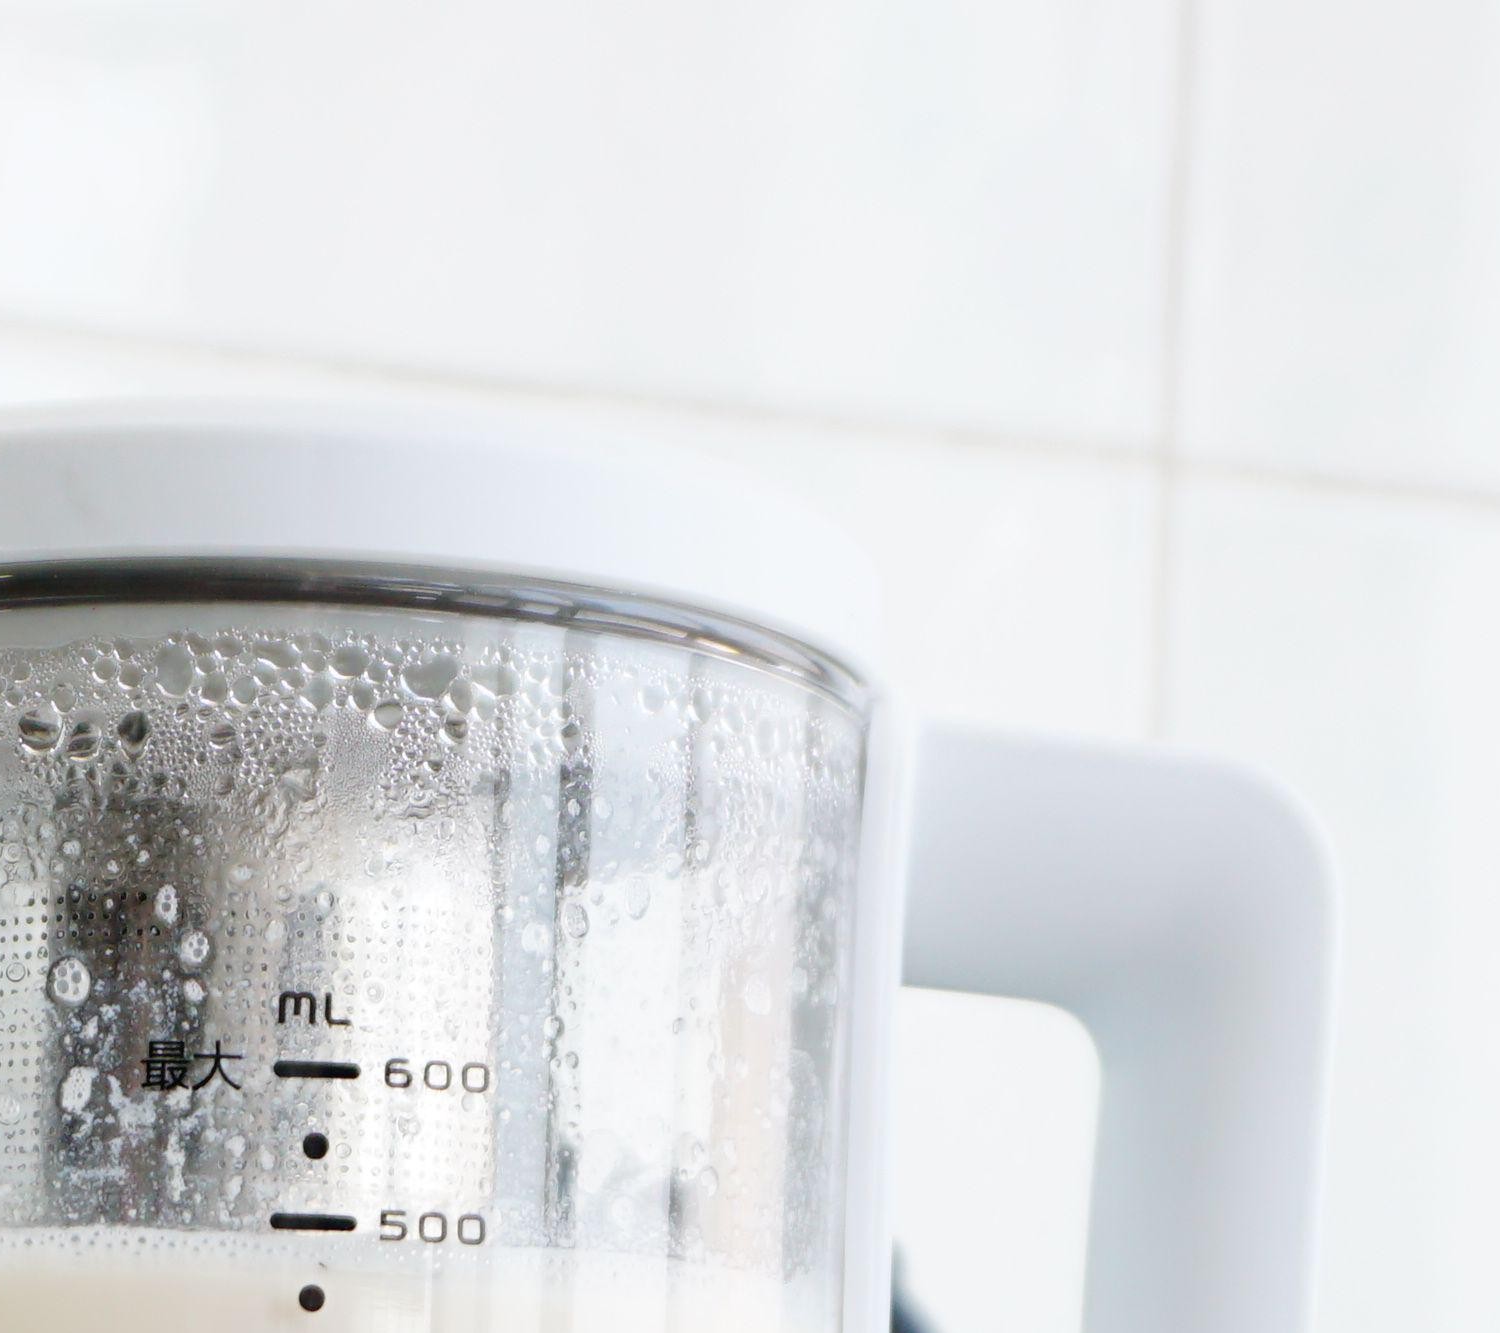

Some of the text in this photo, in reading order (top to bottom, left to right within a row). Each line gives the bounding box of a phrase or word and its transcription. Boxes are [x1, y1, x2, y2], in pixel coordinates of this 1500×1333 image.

[140, 1039, 491, 1094] 最大 600
[378, 1209, 487, 1246] 500
